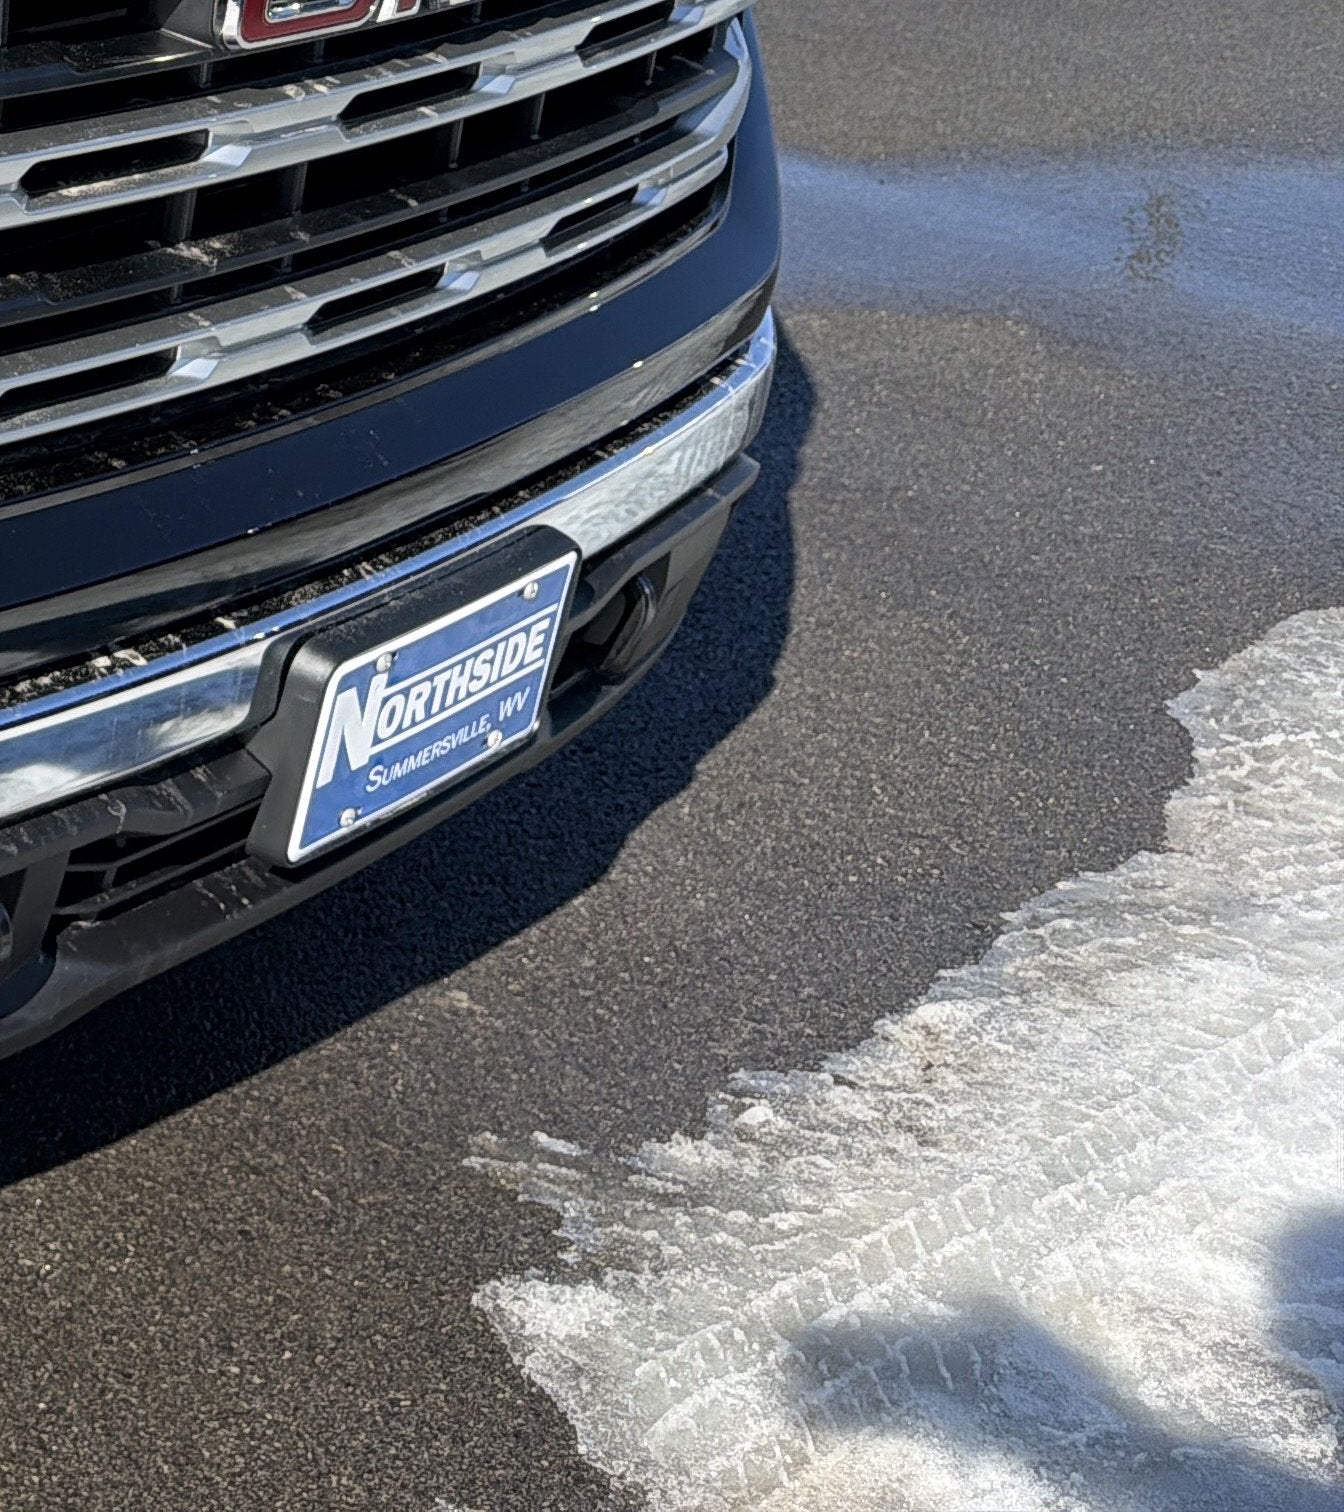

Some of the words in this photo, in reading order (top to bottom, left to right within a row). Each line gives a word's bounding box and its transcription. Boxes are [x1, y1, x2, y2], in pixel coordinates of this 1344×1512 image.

[316, 618, 552, 789] NORTHSIDE
[366, 713, 492, 793] SUMMERSVILLE,
[498, 686, 532, 724] WV
